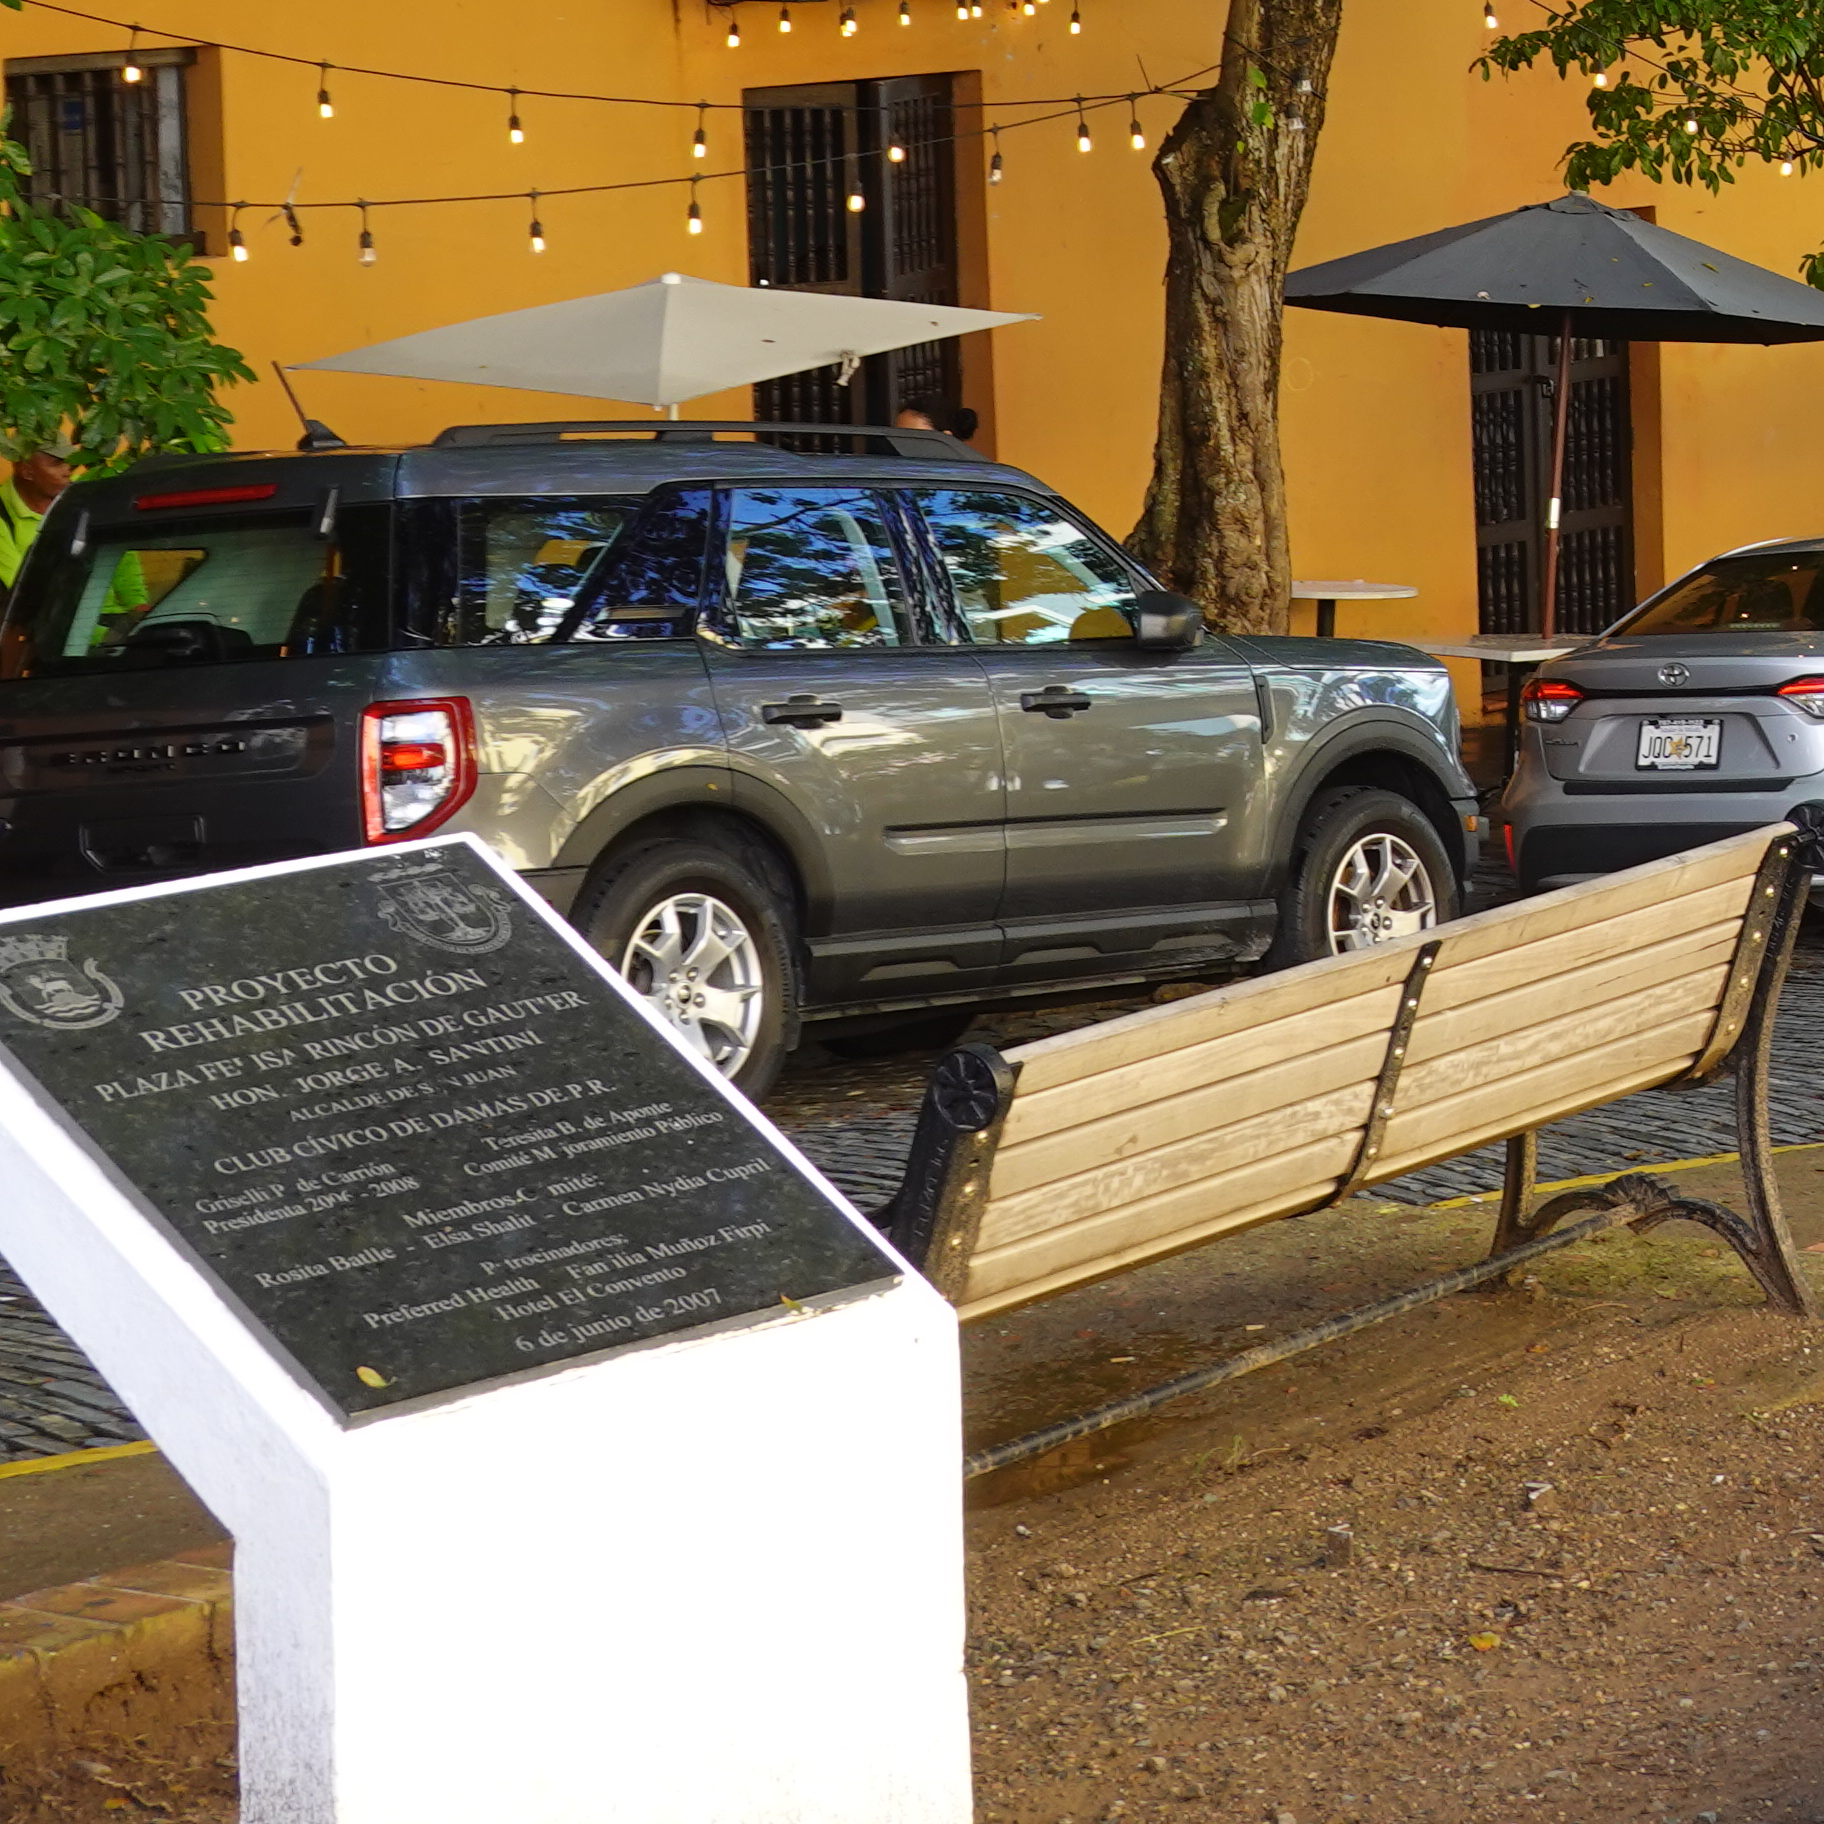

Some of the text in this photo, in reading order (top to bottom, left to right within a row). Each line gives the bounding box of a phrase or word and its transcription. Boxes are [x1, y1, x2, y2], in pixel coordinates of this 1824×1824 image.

[1683, 735, 1713, 759] 571
[138, 968, 488, 1053] REHABILITACIÓN
[178, 954, 398, 1011] PROYECTO
[94, 1068, 201, 1102] PLAZA
[303, 1024, 420, 1060] RINCÓN
[417, 1015, 464, 1037] DE
[208, 1029, 545, 1111] HON. JORGE A. SANTINI
[289, 1064, 518, 1123] ALCALDE DE SN JUAN
[213, 1078, 617, 1175] CLUB CÍVICO DE DAMAS DE P.R.
[463, 1110, 725, 1177] Comité Mjoramiento Público
[481, 1099, 673, 1152] Teresita B. de Aponte
[195, 1185, 271, 1213] Griselli
[296, 1177, 323, 1193] de
[321, 1161, 398, 1187] Carrión
[202, 1200, 309, 1235] Presidenta
[367, 1176, 421, 1198] 2008
[402, 1172, 605, 1228] Miembros Cmité:
[254, 1262, 331, 1288] Rosita
[328, 1246, 398, 1272] Batlle
[422, 1229, 475, 1250] Elsa
[471, 1213, 538, 1238] Shalit
[562, 1188, 646, 1217] Carmen
[640, 1174, 707, 1199] Nydia
[705, 1156, 773, 1185] Cupril
[361, 1292, 468, 1330] Preferred
[463, 1275, 542, 1301] Health
[644, 1233, 722, 1260] Muñoz
[717, 1218, 773, 1244] Firpi
[479, 1232, 630, 1276] Ptrocinadores:
[494, 1265, 688, 1321] Hotel El Convento
[514, 1287, 723, 1353] 6 de junio de 2007
